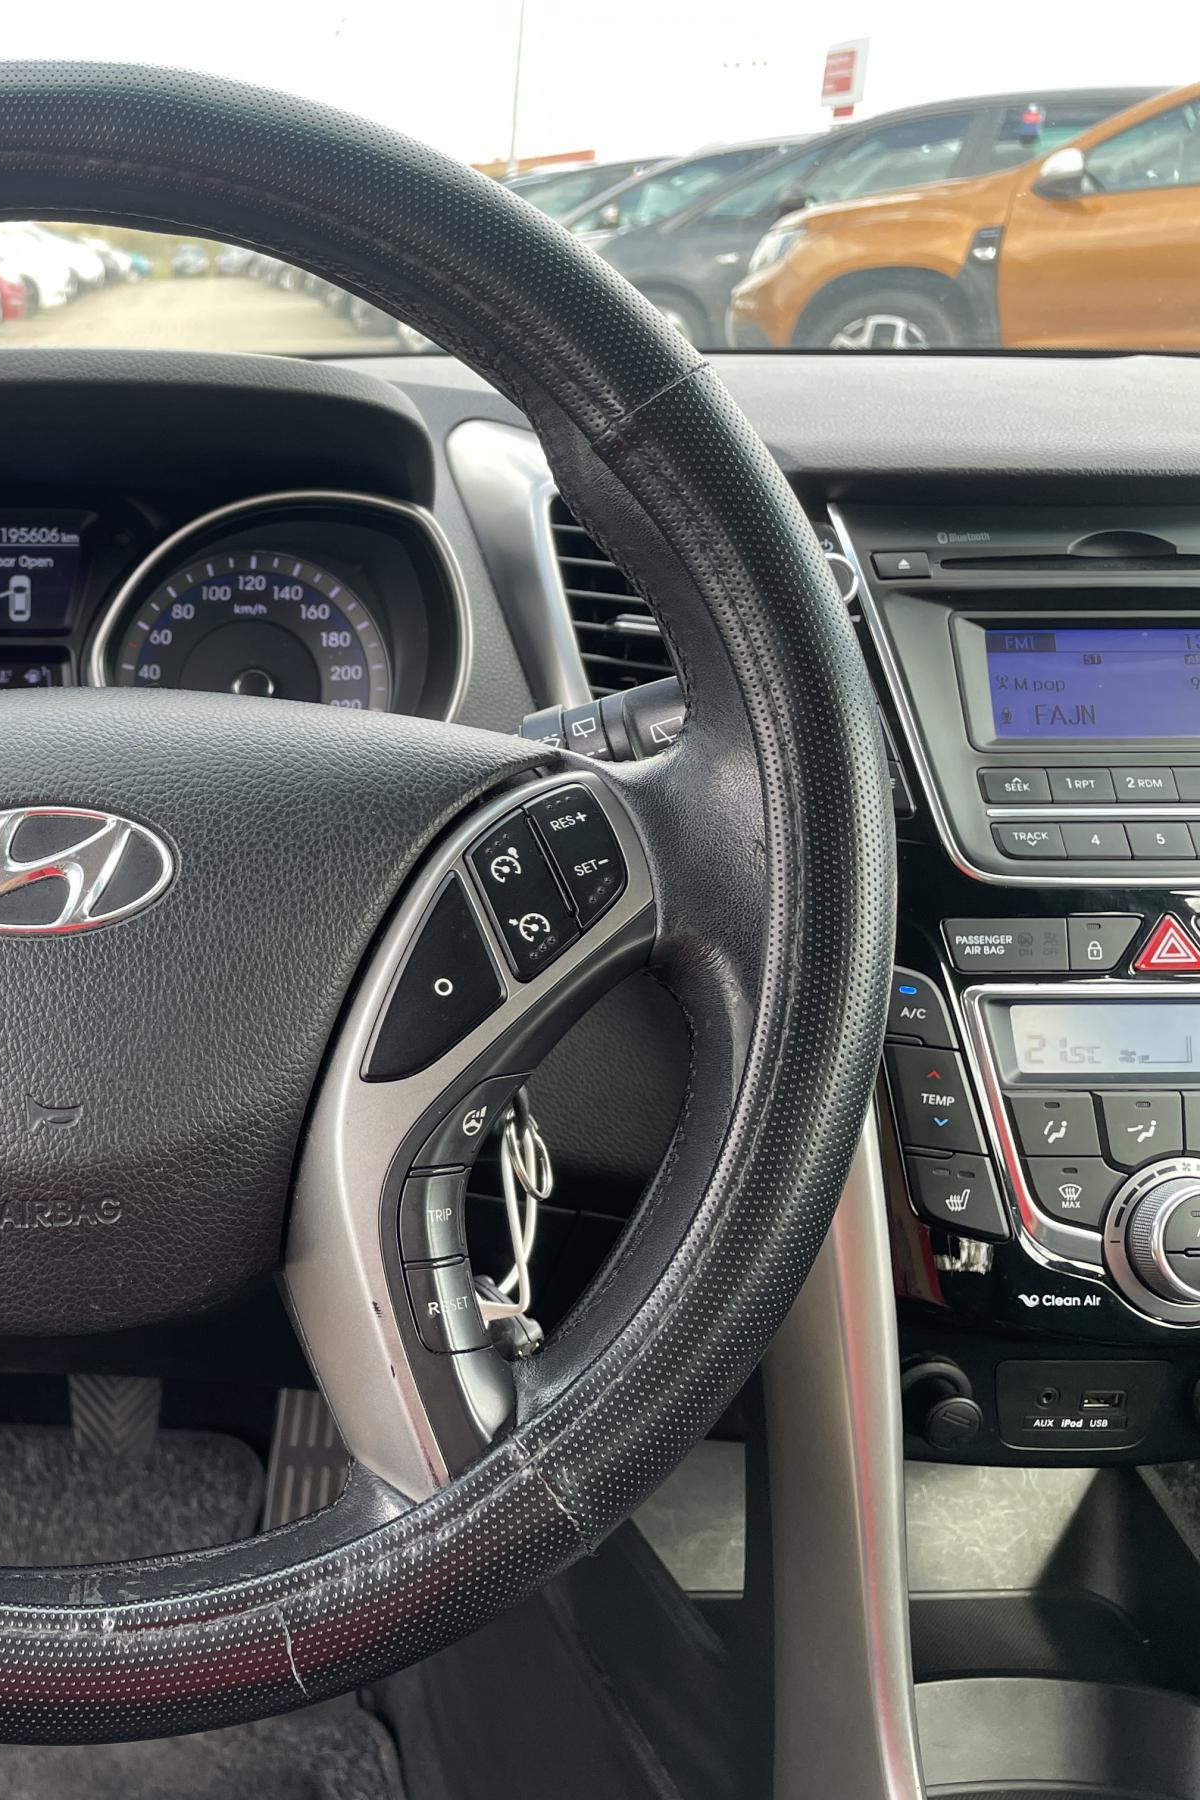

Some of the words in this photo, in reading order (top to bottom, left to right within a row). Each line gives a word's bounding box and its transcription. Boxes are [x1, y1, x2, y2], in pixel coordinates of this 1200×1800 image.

[0, 528, 59, 543] 195606
[948, 532, 991, 543] Bluetooth
[18, 555, 54, 569] Open
[238, 575, 266, 592] 120
[202, 586, 231, 600] 100
[273, 585, 303, 600] 140
[171, 604, 194, 620] 80
[233, 604, 267, 615] km/h
[300, 604, 330, 620] 160
[150, 629, 172, 645] 60
[320, 631, 351, 647] 180
[138, 665, 161, 680] 40
[330, 665, 363, 681] 200
[1014, 678, 1028, 690] M
[1033, 679, 1066, 692] pop
[1034, 704, 1096, 725] FAJN
[1005, 783, 1031, 792] SEEK
[1065, 778, 1073, 789] 1
[1074, 779, 1096, 789] RPT
[1126, 777, 1136, 789] 2
[1137, 778, 1163, 788] RDM
[1012, 832, 1049, 841] TRACK
[1091, 834, 1101, 845] 4
[1156, 833, 1166, 845] 5
[955, 935, 1013, 945] PASSENGER
[964, 946, 981, 955] AIR
[983, 945, 1005, 955] BAG
[900, 1007, 927, 1019] A/C
[921, 1093, 955, 1107] TEMP
[428, 1207, 452, 1222] TRIP
[1042, 1294, 1081, 1307] Clean
[1084, 1294, 1102, 1307] Air
[1033, 1419, 1054, 1428] AUX
[1061, 1418, 1083, 1428] iPod
[1089, 1419, 1108, 1428] USB
